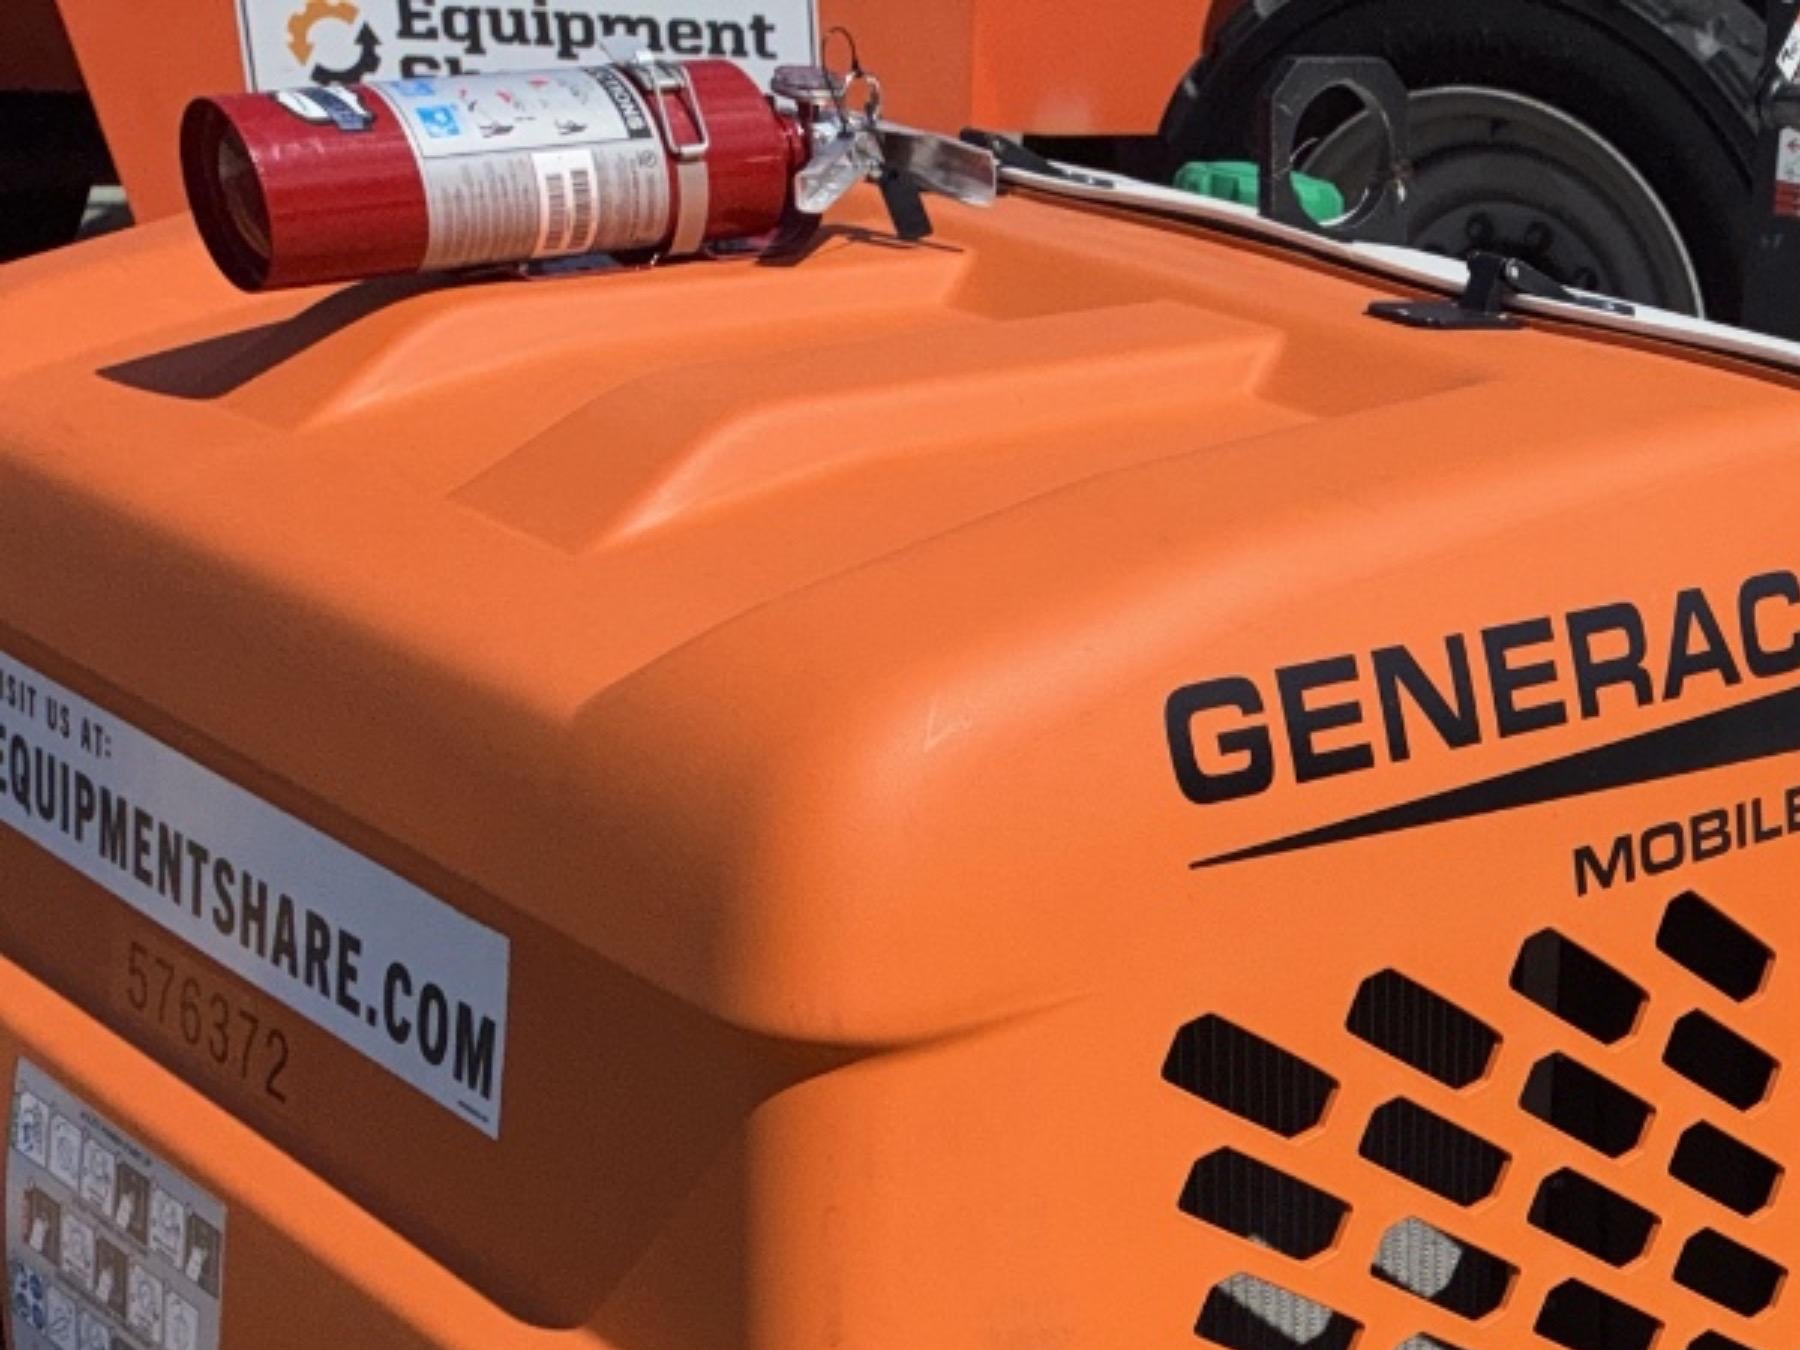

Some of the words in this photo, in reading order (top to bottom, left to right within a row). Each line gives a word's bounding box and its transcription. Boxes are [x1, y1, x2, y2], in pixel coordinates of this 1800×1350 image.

[395, 0, 777, 60] Equipment
[46, 696, 70, 740] US
[81, 716, 112, 759] AT:
[127, 940, 290, 1105] 576372
